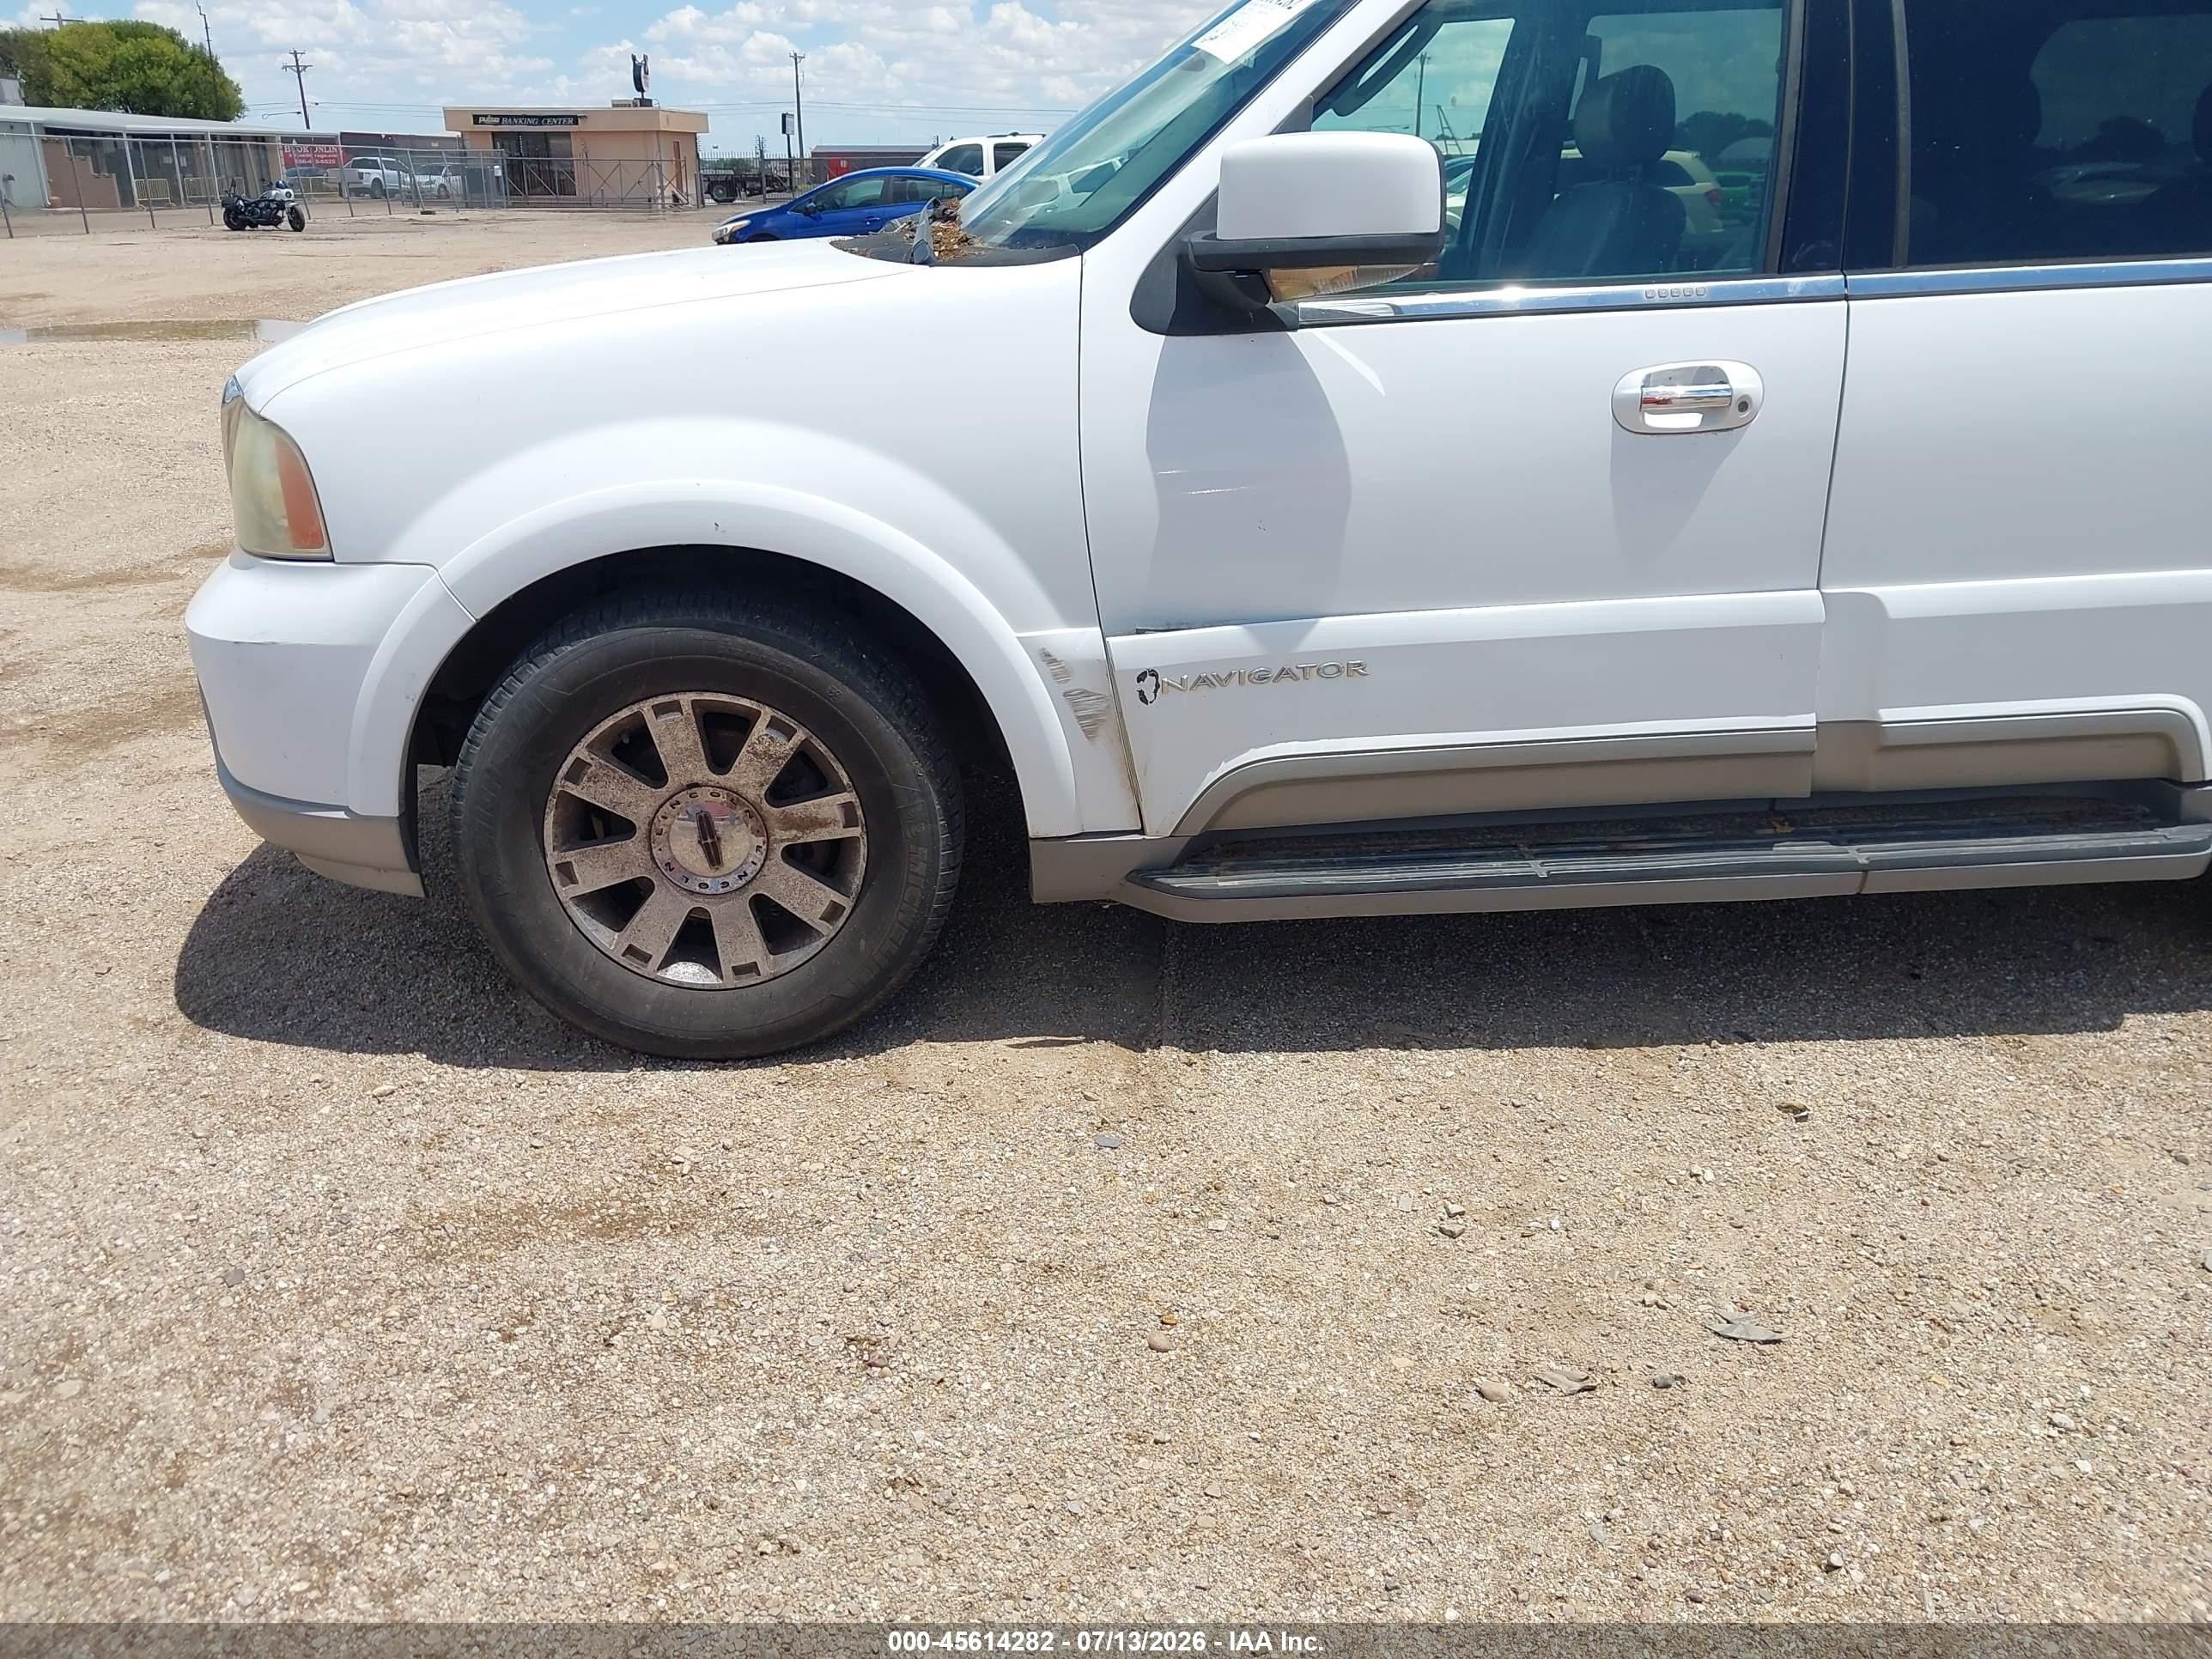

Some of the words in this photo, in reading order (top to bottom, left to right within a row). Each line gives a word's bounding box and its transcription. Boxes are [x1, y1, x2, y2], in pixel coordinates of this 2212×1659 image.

[501, 117, 538, 125] BANKING
[541, 117, 574, 125] CENTER
[1162, 659, 1370, 695] NAVIGATOR
[655, 791, 754, 836] LINCOLN
[664, 844, 763, 890] LINCOLN
